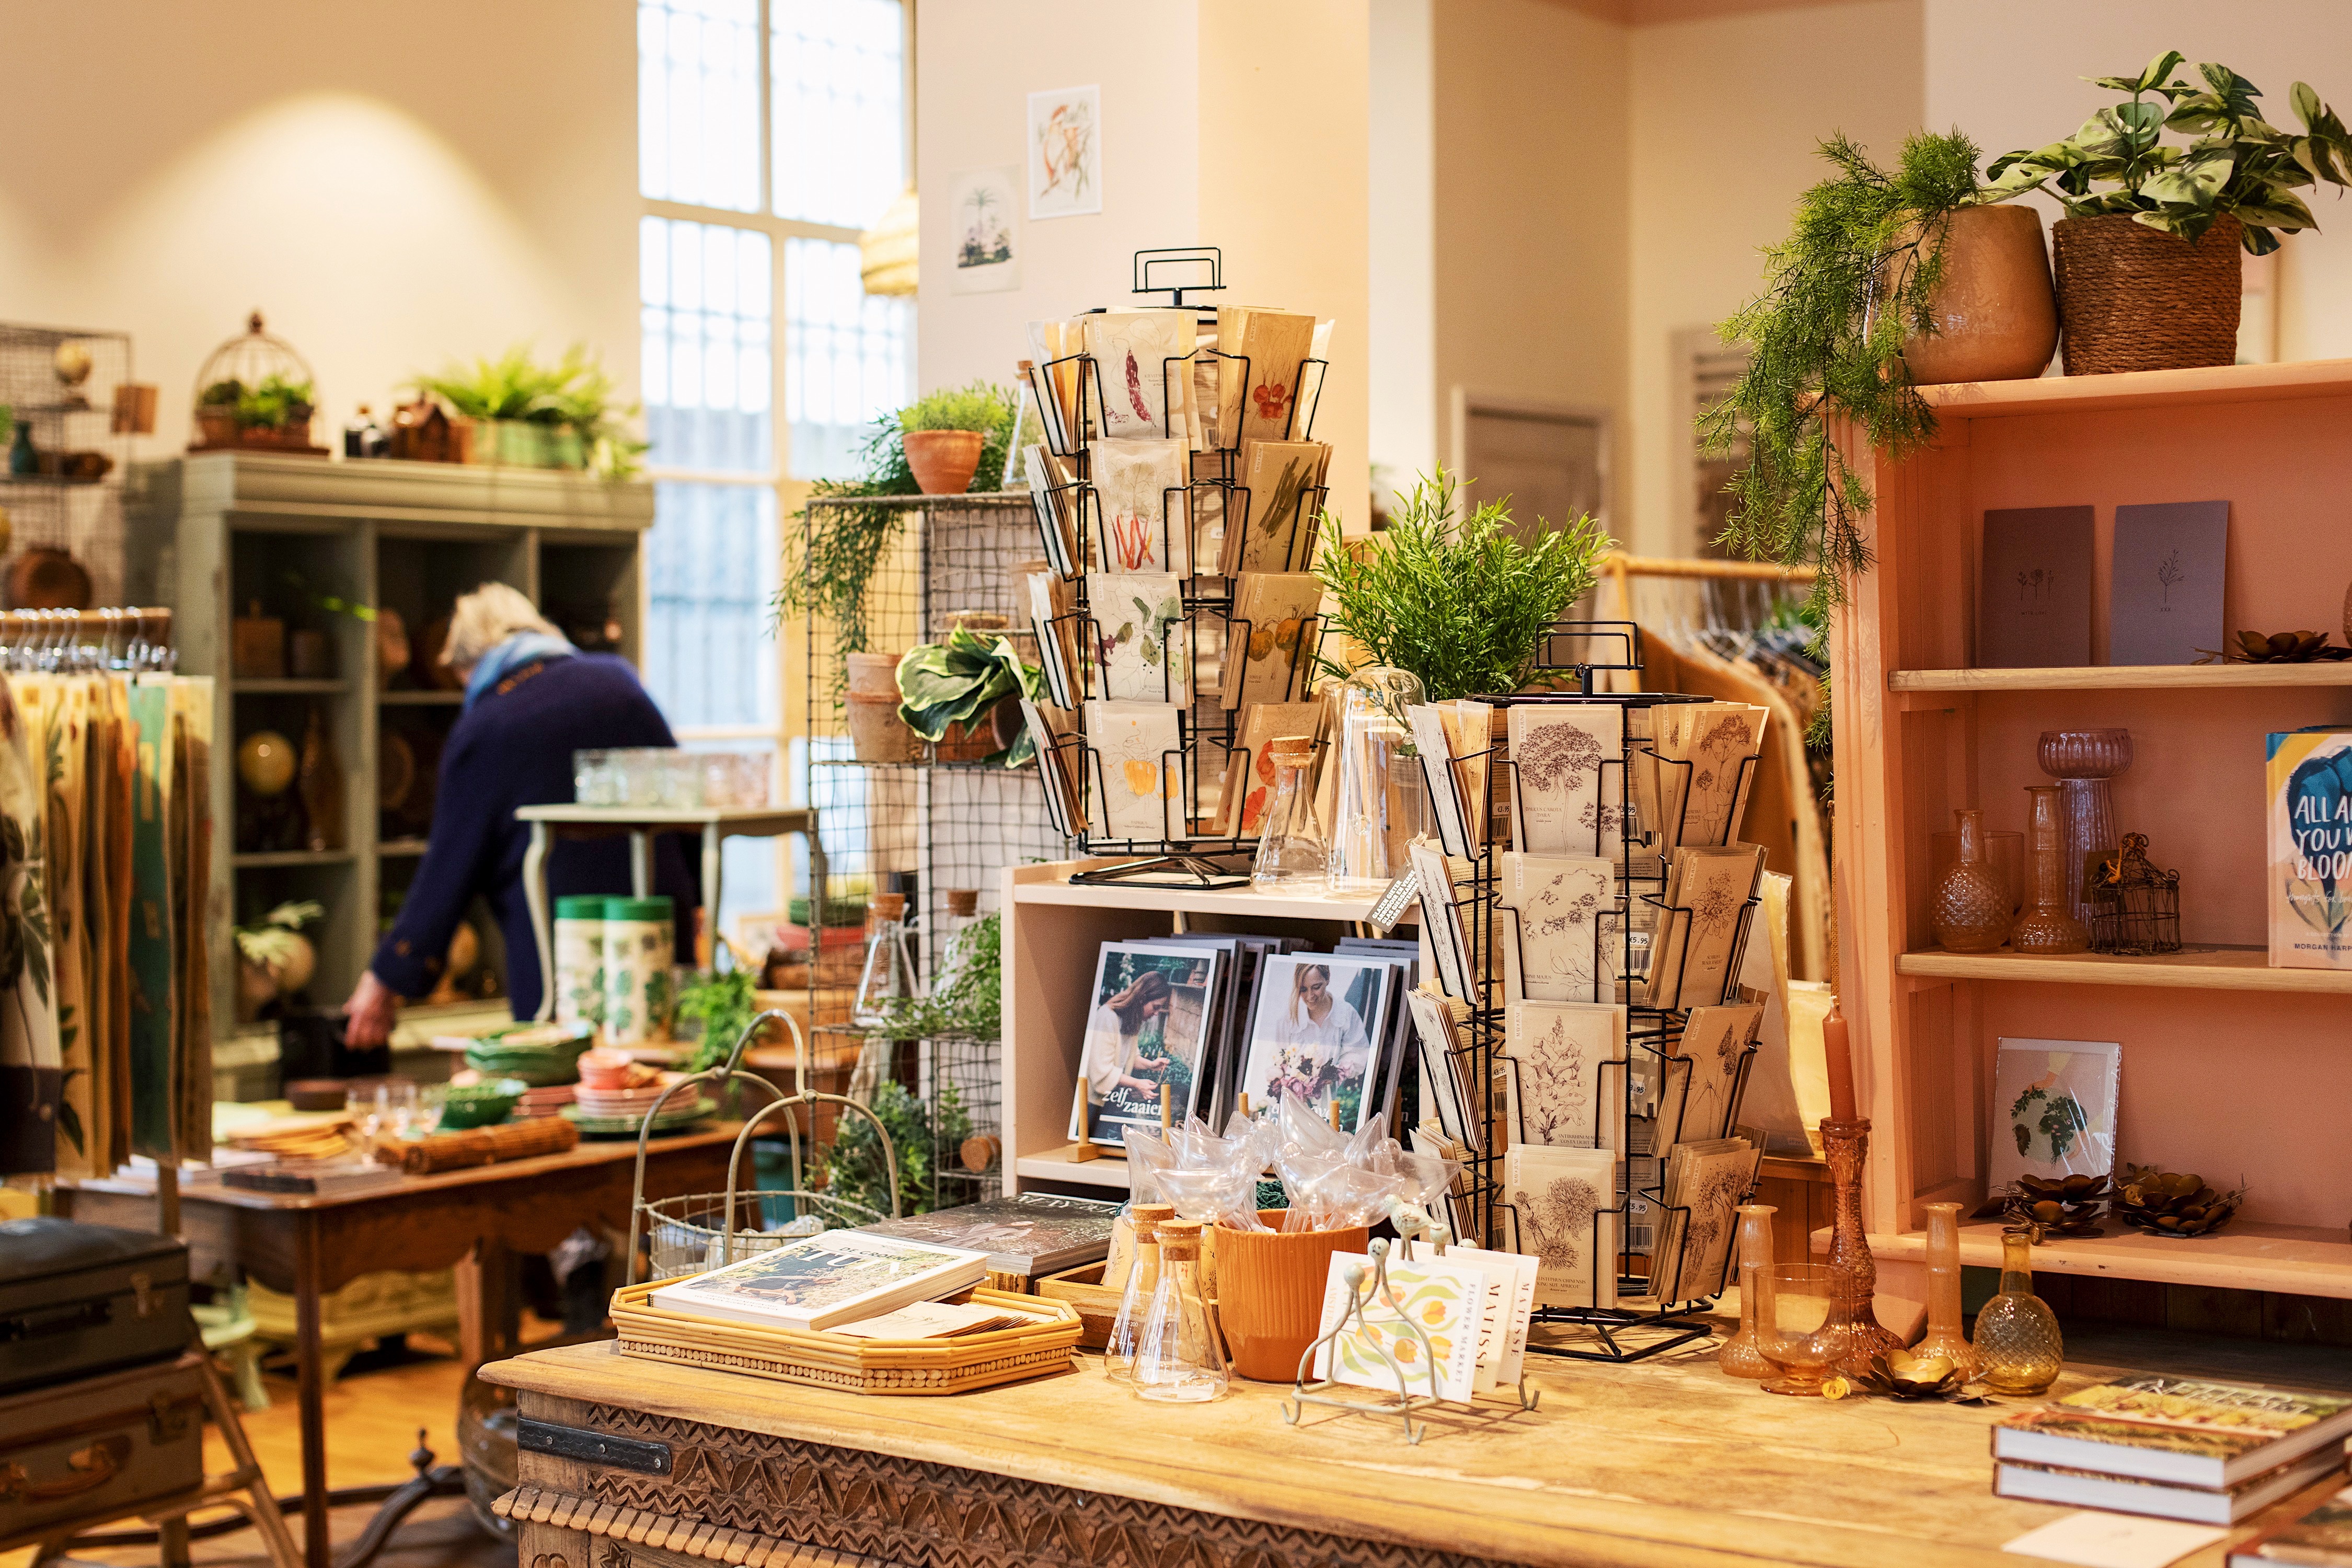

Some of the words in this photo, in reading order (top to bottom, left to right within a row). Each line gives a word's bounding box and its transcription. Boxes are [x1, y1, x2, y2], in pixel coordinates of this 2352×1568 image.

[2294, 795, 2331, 824] ALL
[2295, 828, 2342, 856] YOU
[1372, 898, 1389, 919] GLAZEN
[1386, 880, 1402, 900] GIETER
[1377, 893, 1399, 923] ARROSOIR
[1396, 886, 1404, 895] EN
[1401, 869, 1416, 887] VERRE
[1381, 909, 1394, 924] GLAS
[1391, 877, 1417, 910] GIESSKANNE
[1386, 908, 1401, 927] GLASS
[1398, 882, 1420, 910] WATERING
[1102, 1087, 1132, 1108] zelf
[797, 1247, 918, 1274] TUIN
[859, 1250, 913, 1262] GROENE
[1464, 1283, 1476, 1331] FLOWER
[1475, 1282, 1501, 1375] MATISSE
[1511, 1281, 1530, 1358] MATISSE
[1454, 1335, 1469, 1384] MARKET
